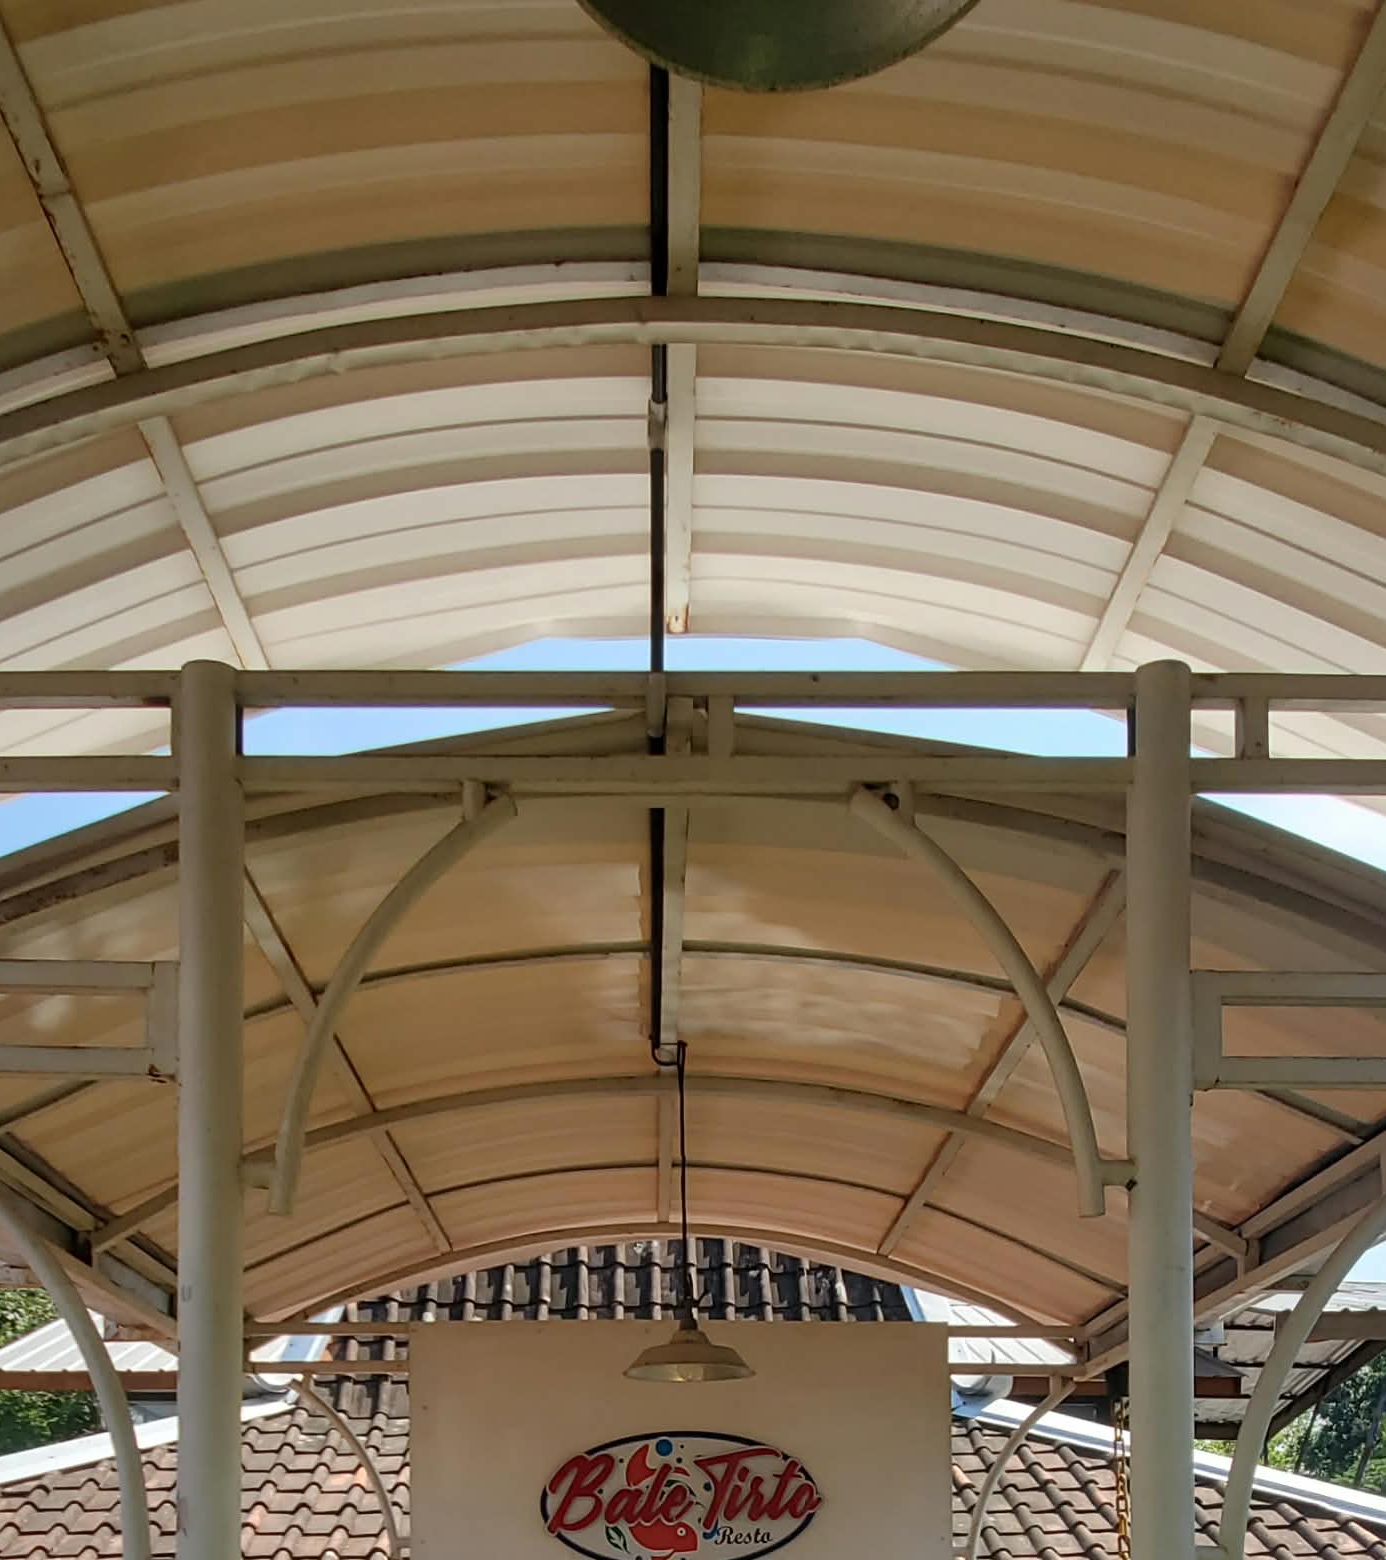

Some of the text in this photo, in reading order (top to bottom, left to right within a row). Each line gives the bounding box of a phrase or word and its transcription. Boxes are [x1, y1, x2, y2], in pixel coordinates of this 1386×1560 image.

[547, 1448, 822, 1534] Bale Tirto
[714, 1526, 773, 1545] Resto
